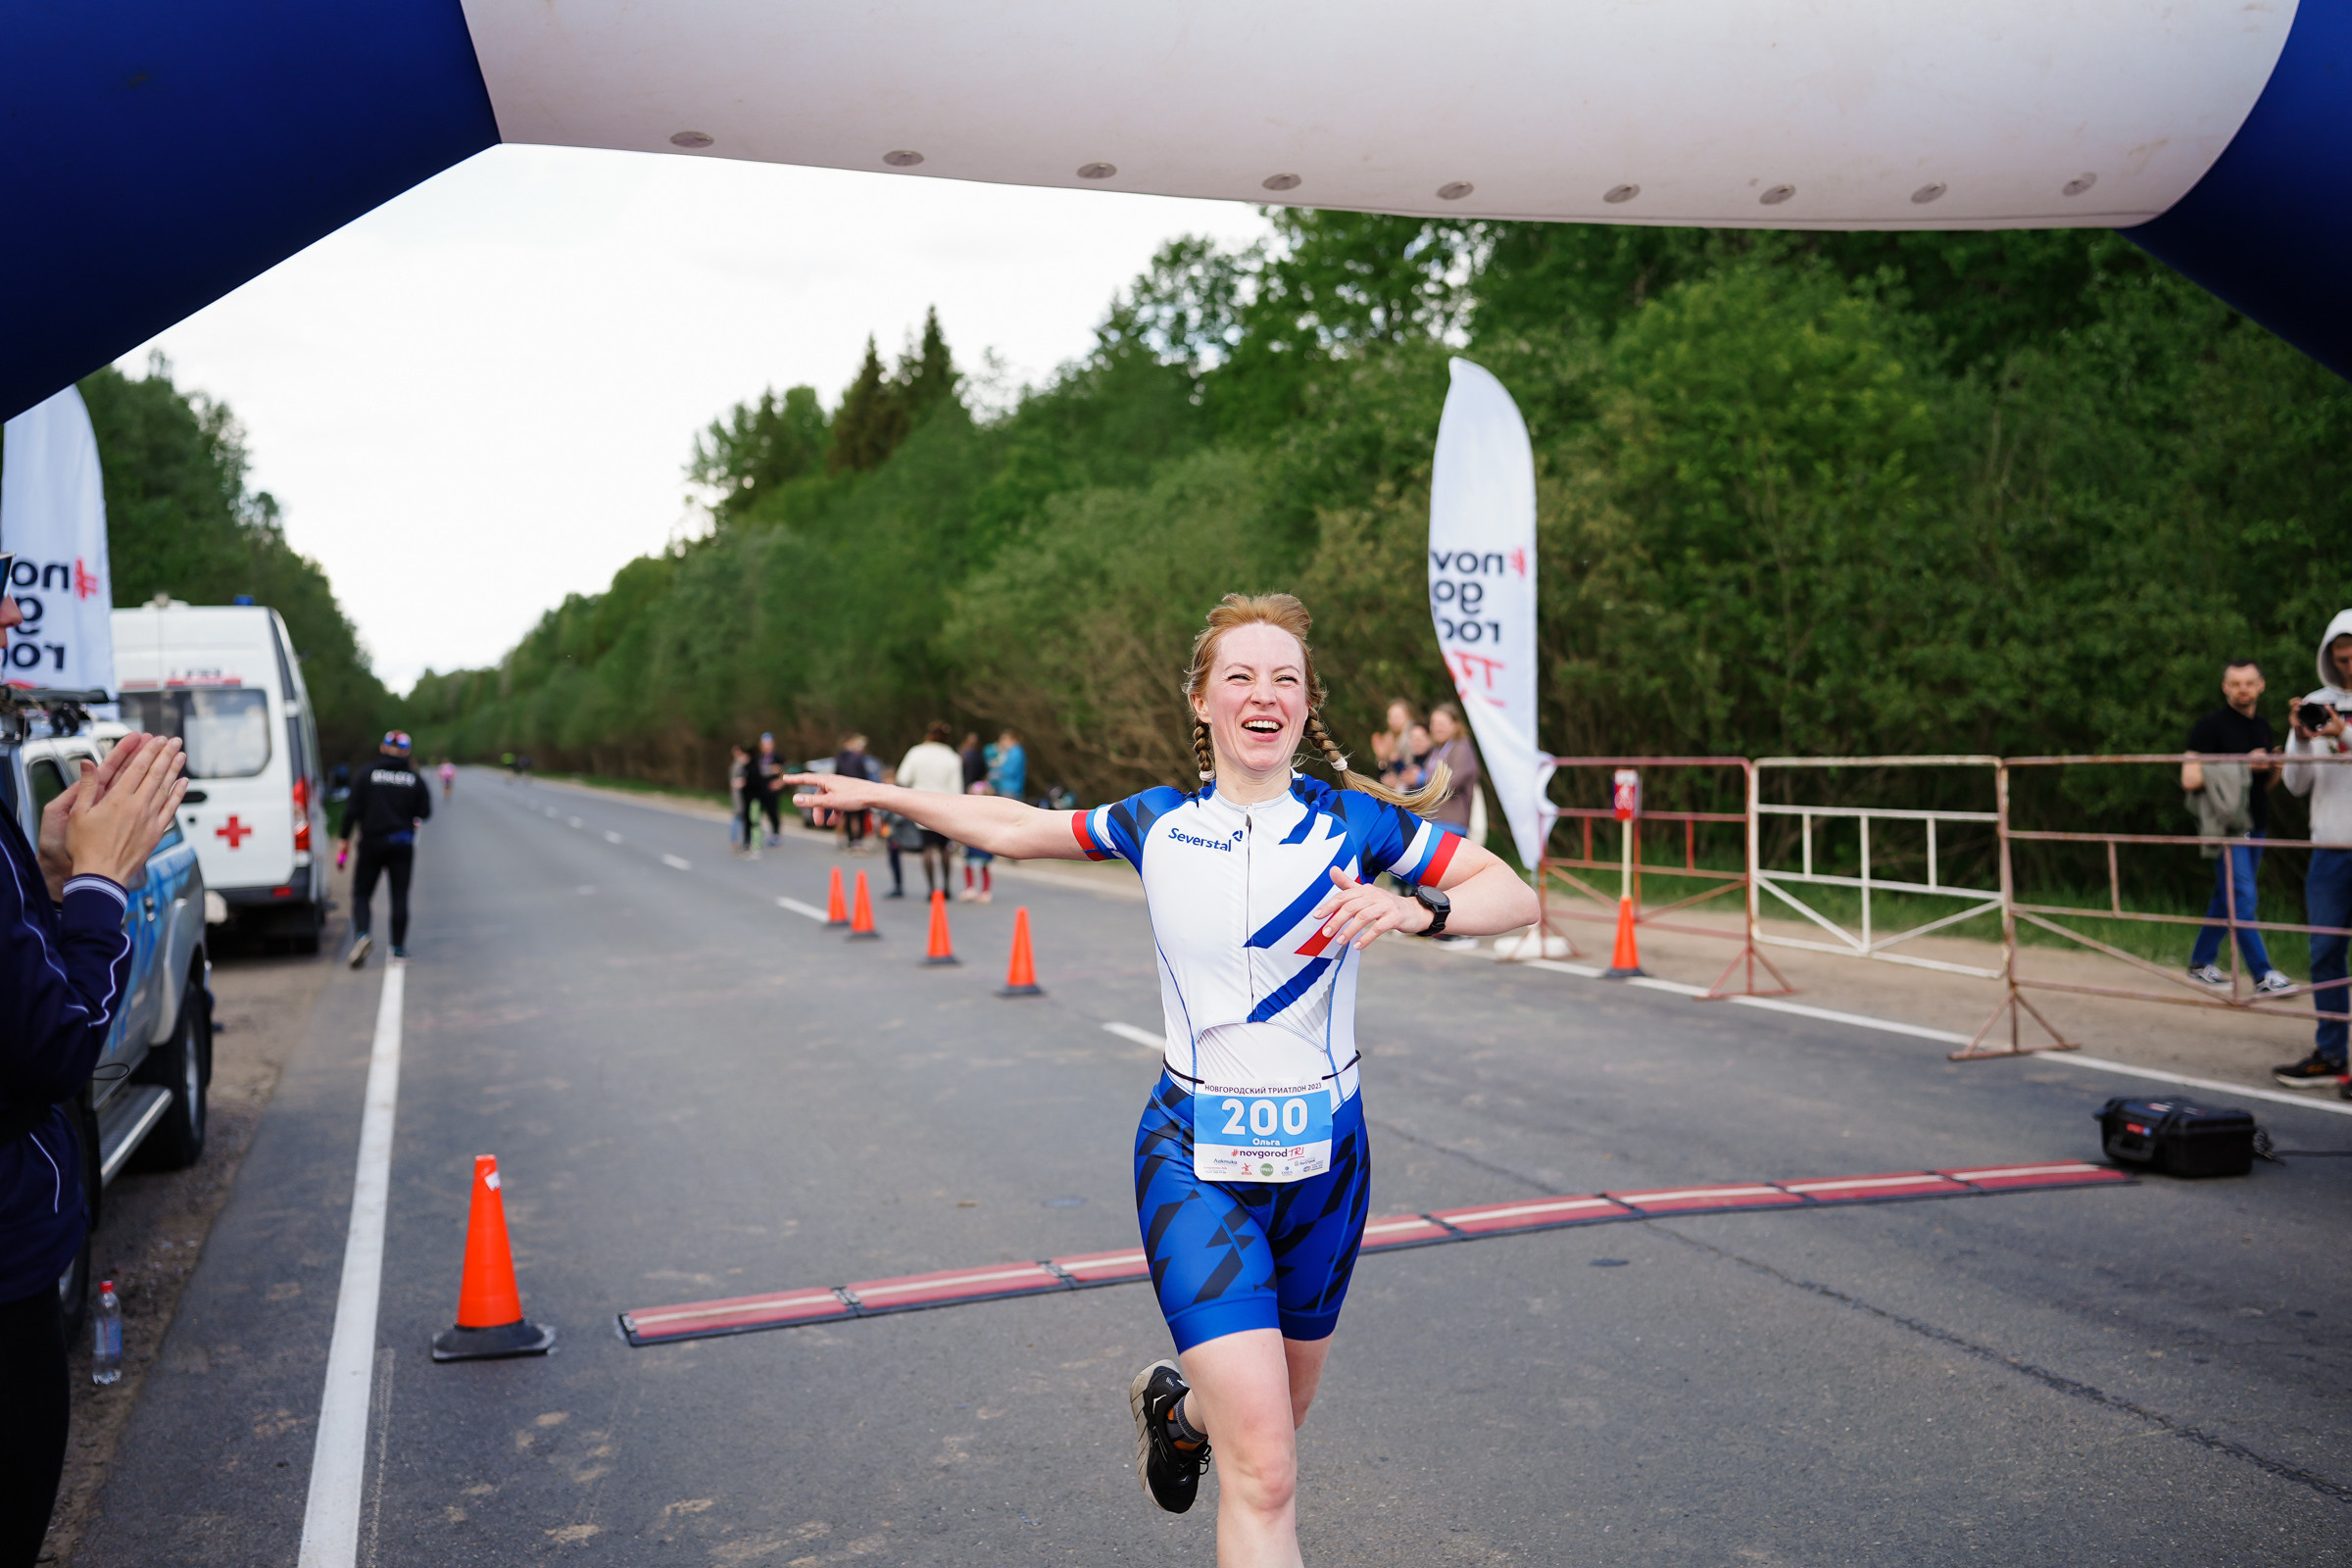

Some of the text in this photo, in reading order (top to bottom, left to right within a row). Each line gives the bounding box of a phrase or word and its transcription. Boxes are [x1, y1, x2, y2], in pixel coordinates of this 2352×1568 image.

[1168, 827, 1232, 852] Severstal
[1204, 1082, 1322, 1095] НОВГОРОДСКИЙ ТРИАТЛОН 2023
[1221, 1098, 1308, 1136] 200
[1252, 1137, 1281, 1147] Ольга
